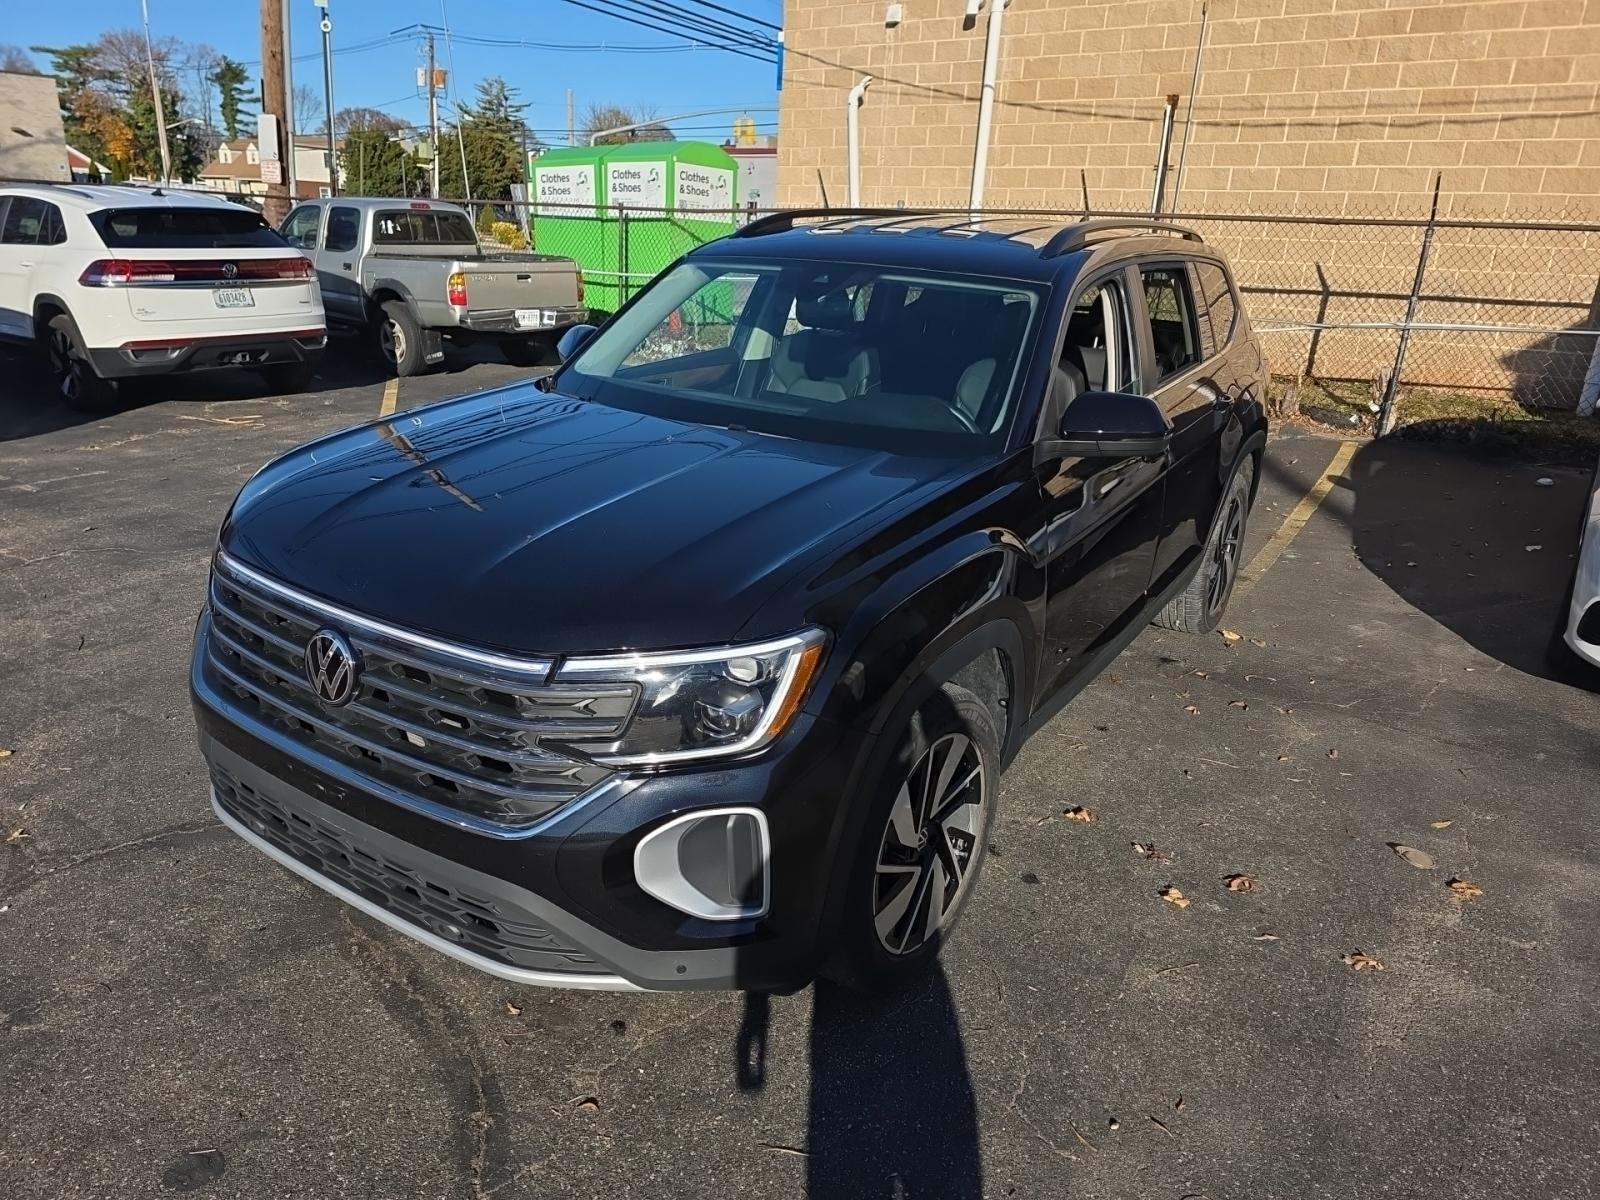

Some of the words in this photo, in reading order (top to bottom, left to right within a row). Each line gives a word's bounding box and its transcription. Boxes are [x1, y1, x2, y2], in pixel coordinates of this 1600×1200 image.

[540, 174, 570, 184] Clothes
[612, 169, 641, 180] Clothes
[680, 170, 710, 184] Clothes
[541, 188, 546, 196] &
[547, 186, 571, 196] Shoes
[612, 183, 617, 192] &
[618, 183, 642, 193] Shoes
[680, 184, 685, 194] &
[686, 185, 710, 197] Shoes
